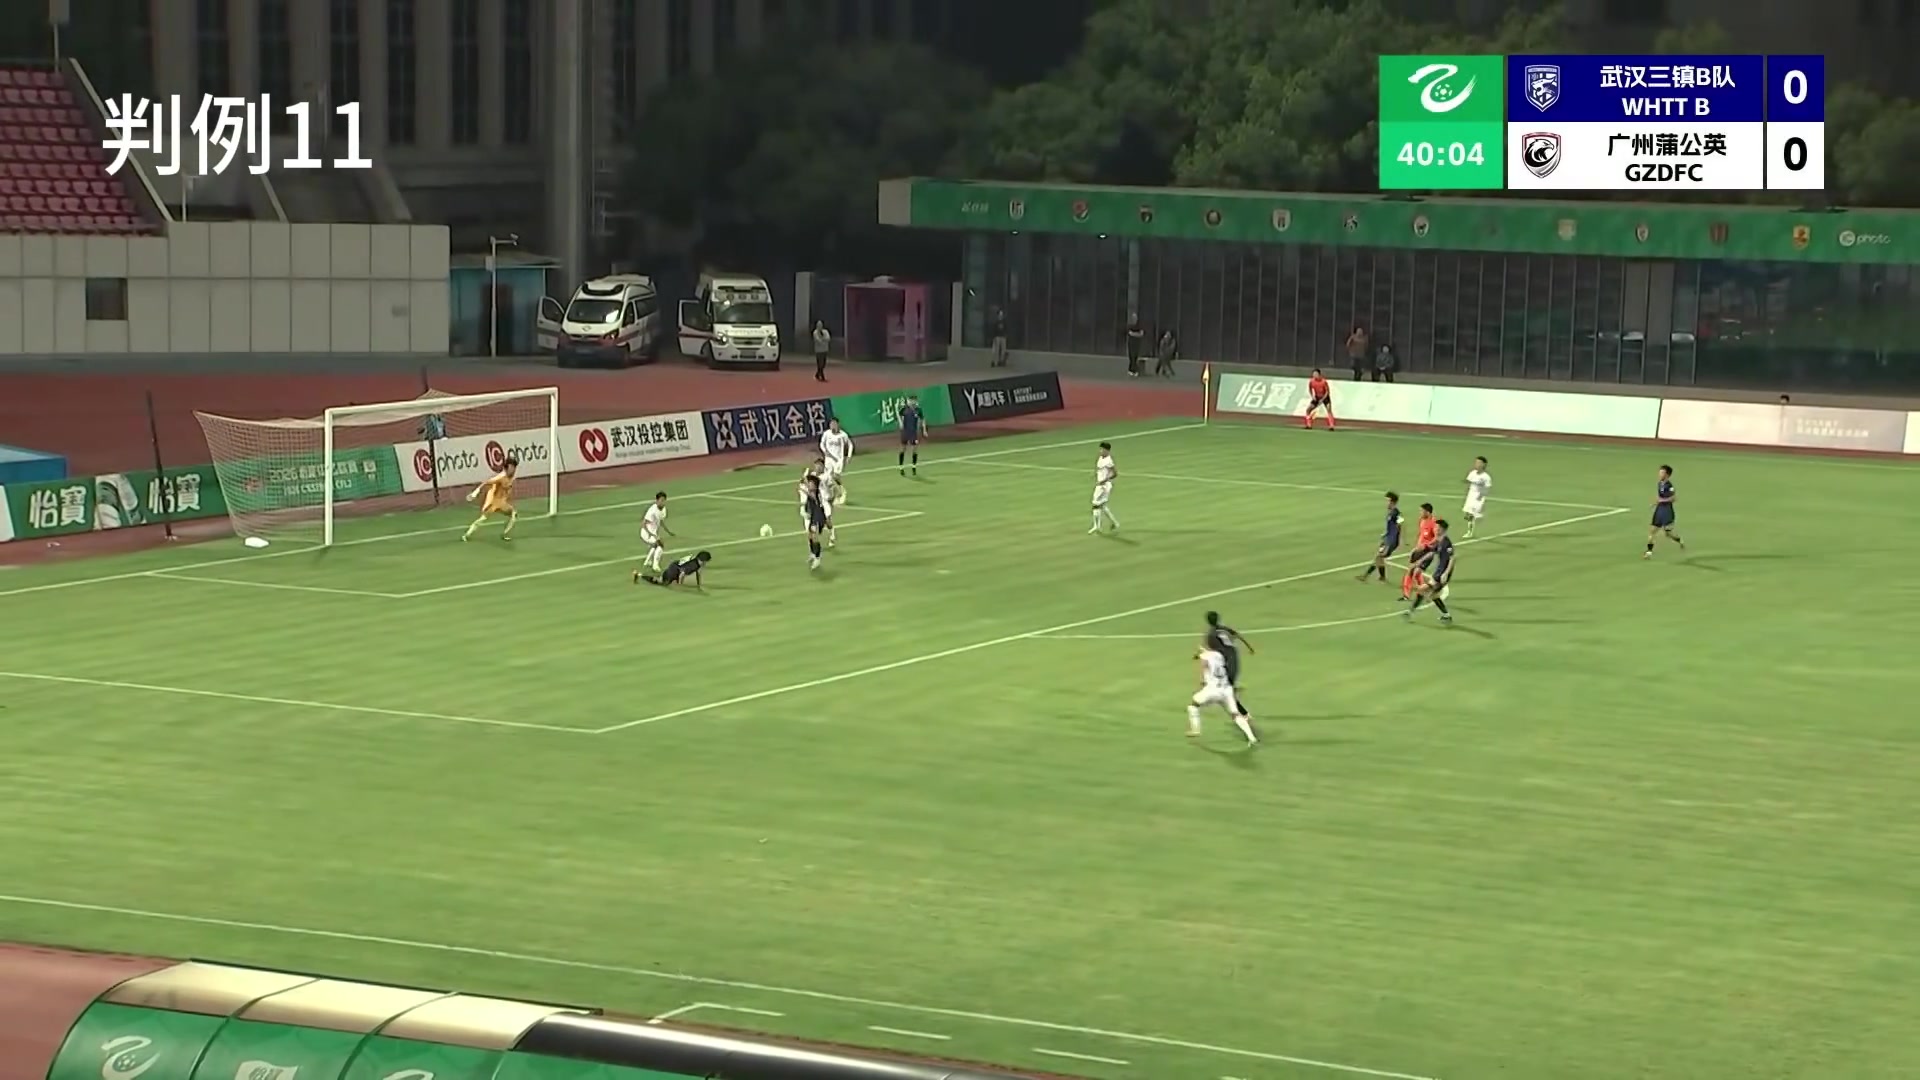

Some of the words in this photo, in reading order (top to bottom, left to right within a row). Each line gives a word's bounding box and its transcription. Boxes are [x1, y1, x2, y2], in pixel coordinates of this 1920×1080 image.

[611, 419, 689, 448] 武汉投控集团
[739, 402, 826, 444] 武汉金控
